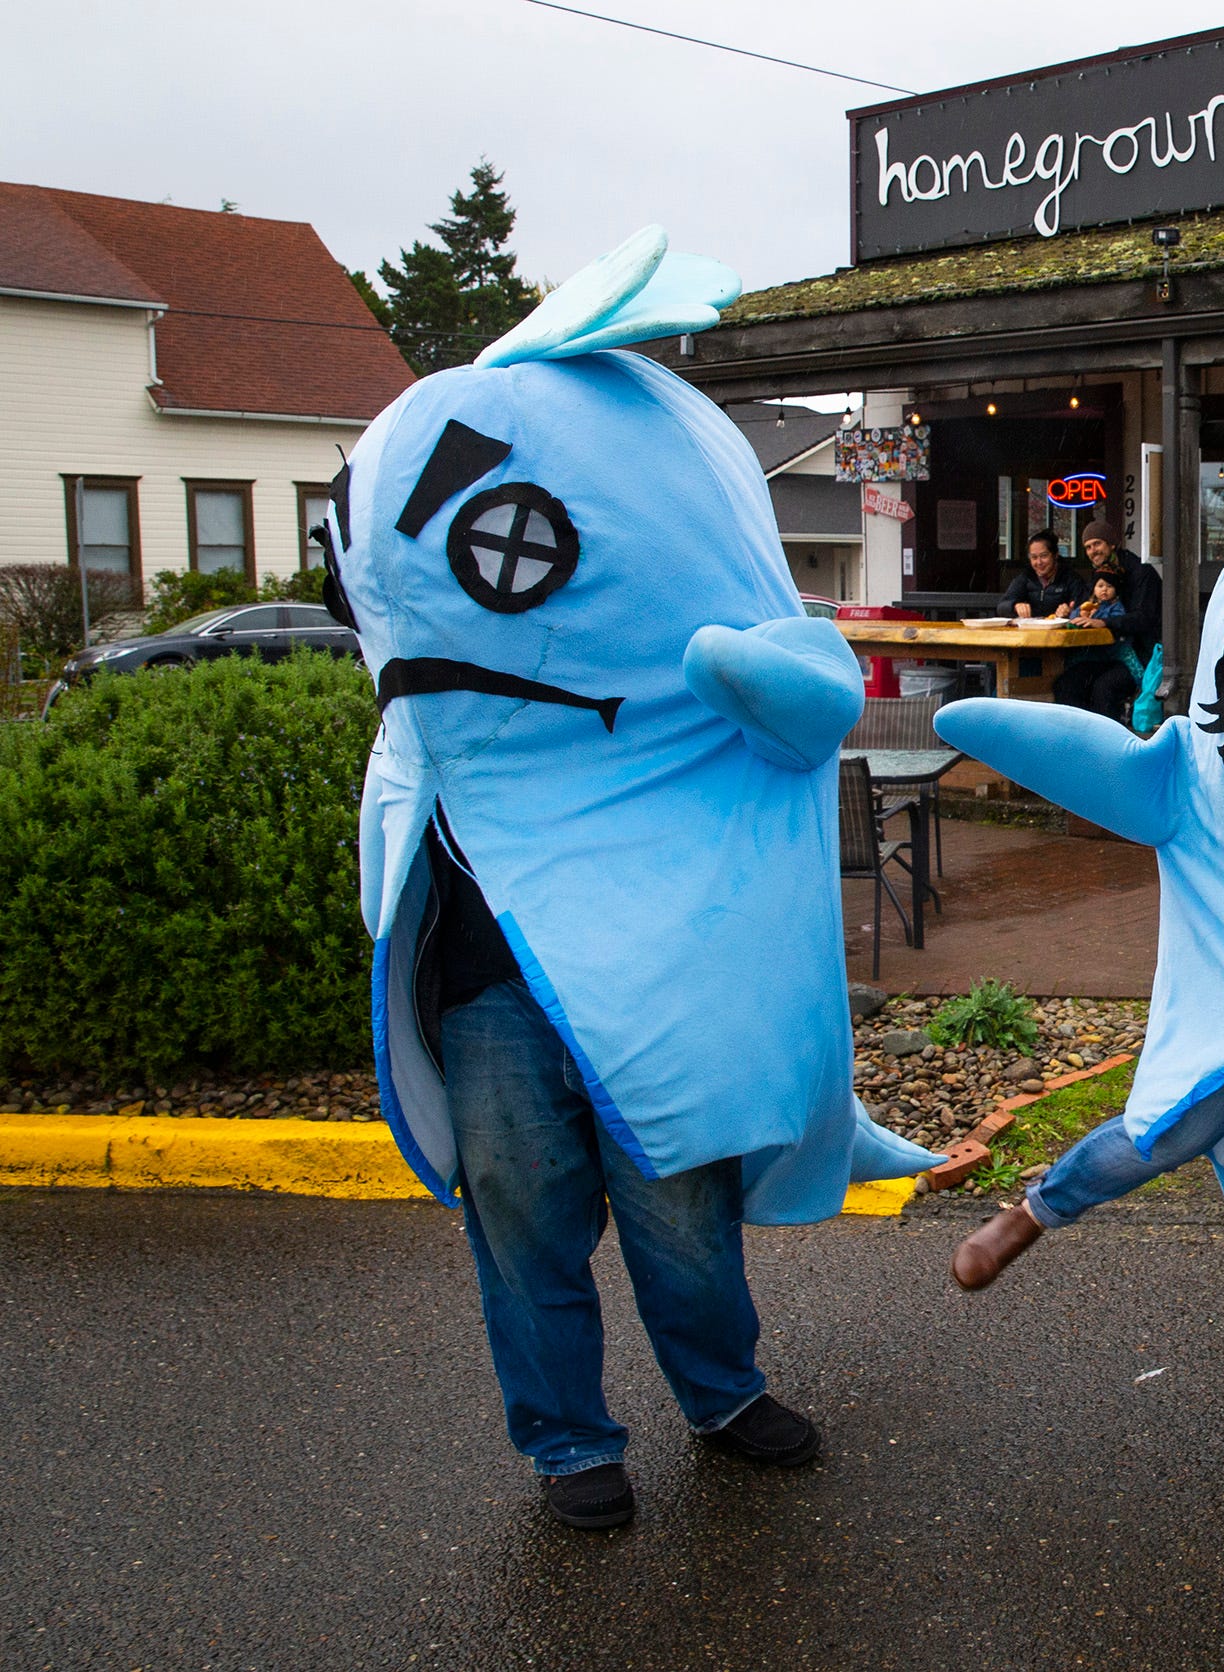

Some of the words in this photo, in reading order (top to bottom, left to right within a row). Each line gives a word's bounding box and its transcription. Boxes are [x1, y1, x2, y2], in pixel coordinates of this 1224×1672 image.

[1047, 479, 1107, 500] OPEN
[875, 494, 898, 517] BEER
[1124, 474, 1135, 540] 294
[849, 609, 871, 618] FREE
